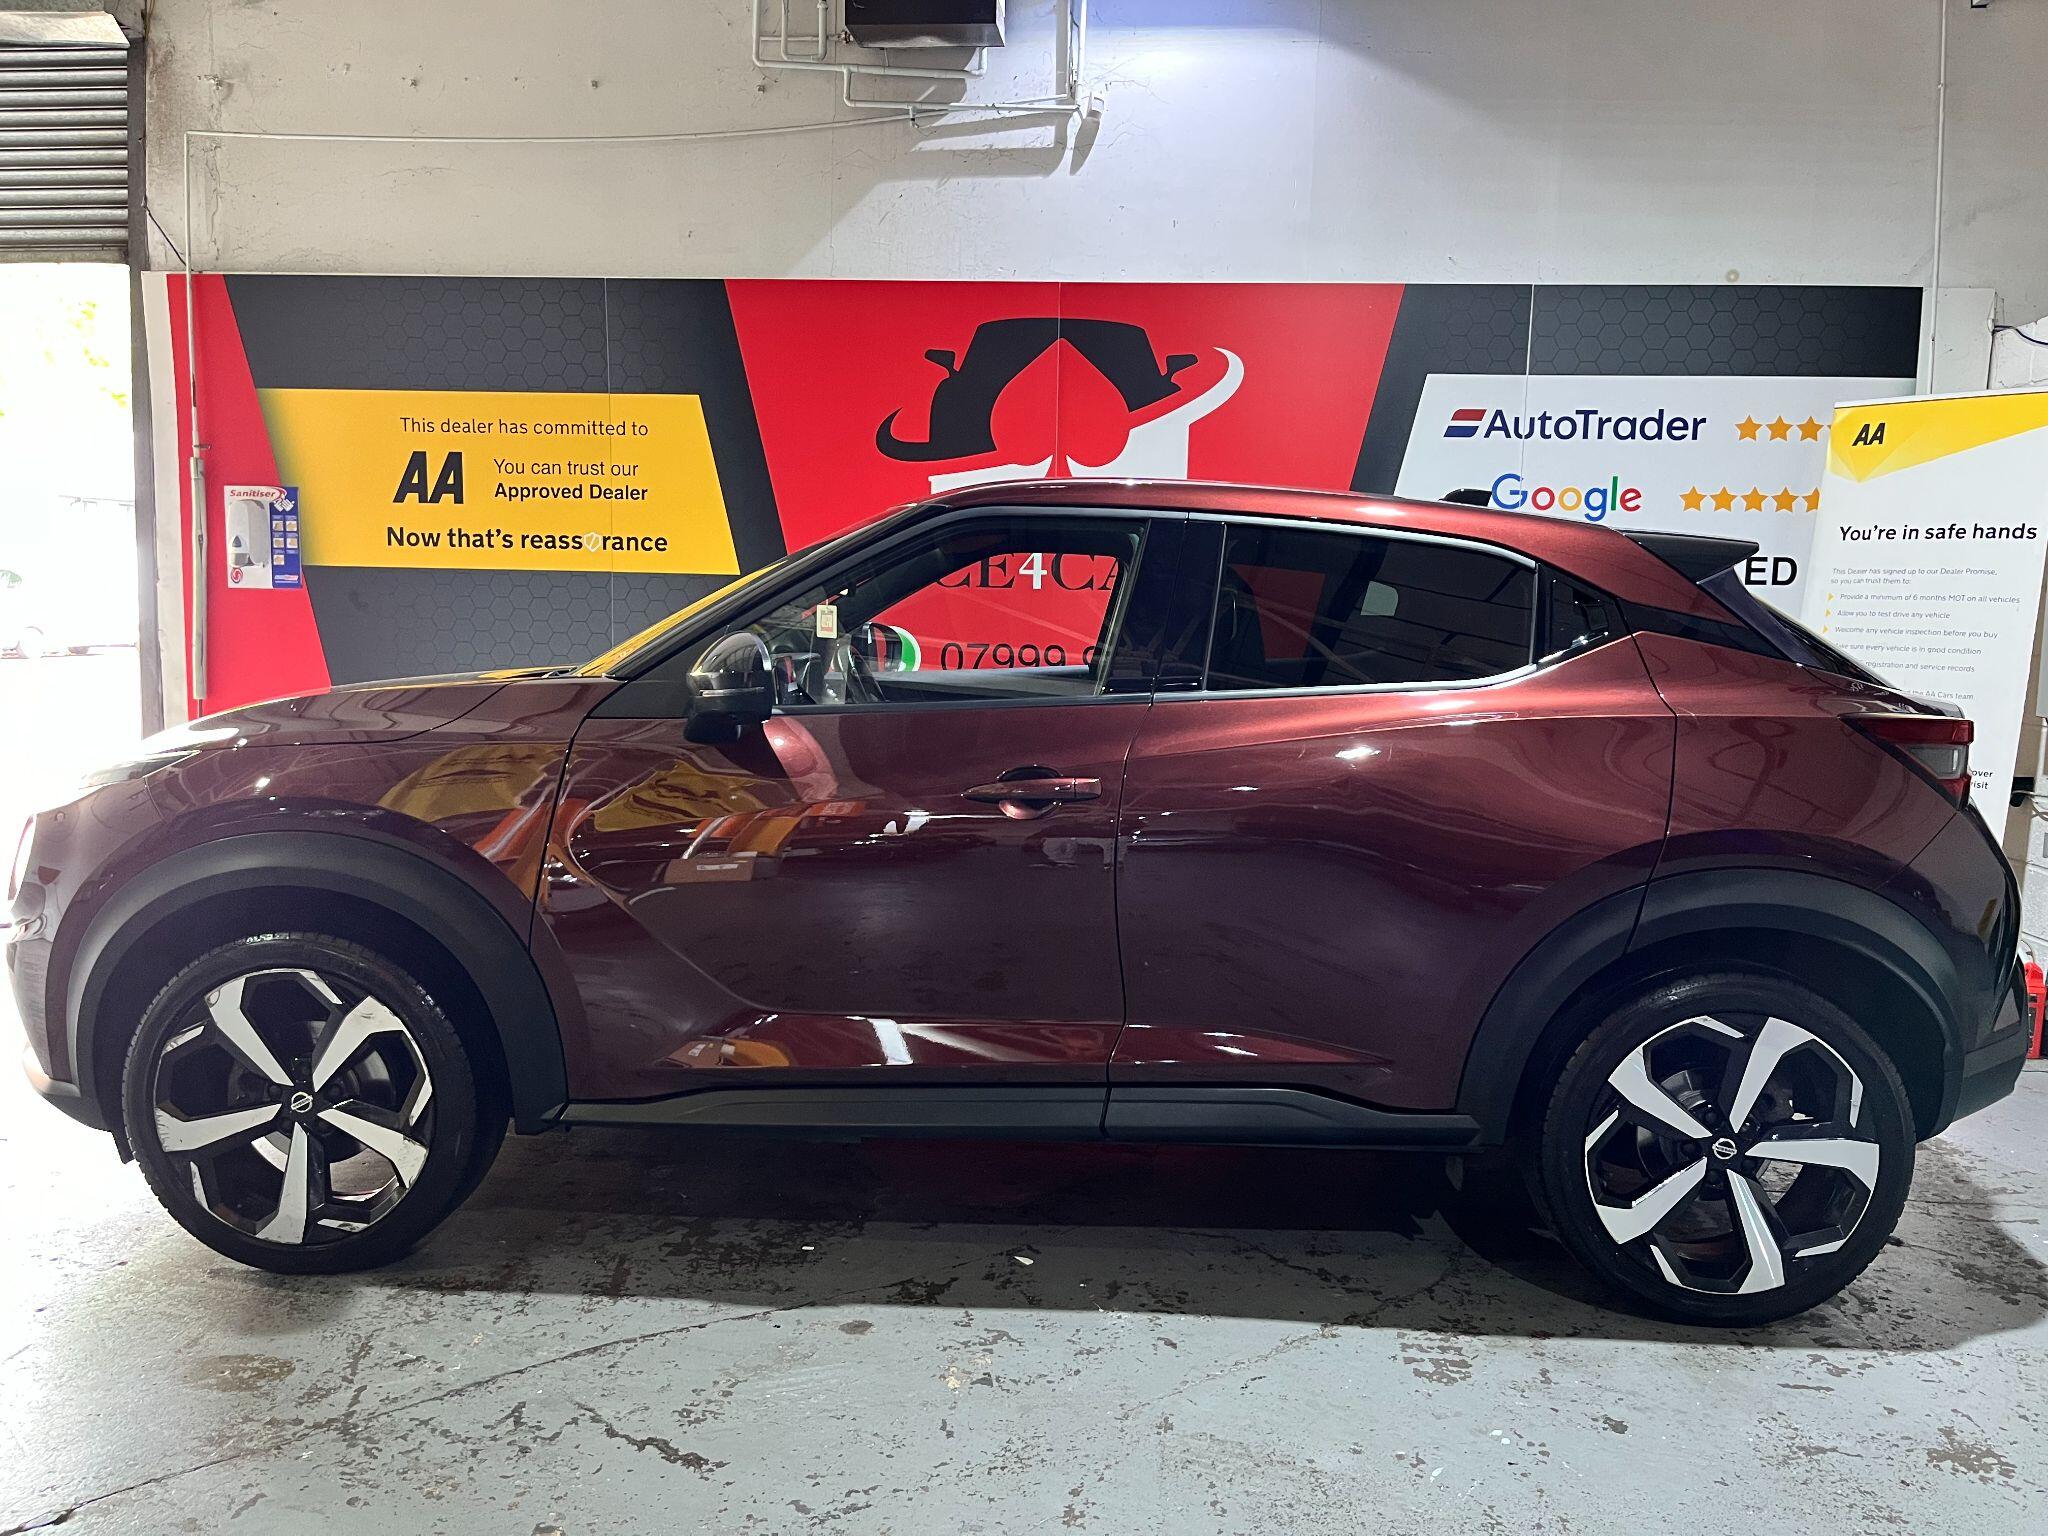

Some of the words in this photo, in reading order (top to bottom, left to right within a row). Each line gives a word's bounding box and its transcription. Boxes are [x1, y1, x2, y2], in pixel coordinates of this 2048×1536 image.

[400, 417, 435, 433] This
[440, 418, 494, 434] dealer
[499, 419, 528, 434] has
[534, 420, 626, 436] committed
[632, 422, 648, 436] to
[1484, 409, 1707, 441] AutoTrader
[1852, 422, 1886, 446] AA
[393, 450, 464, 504] AA
[494, 459, 525, 475] You
[531, 462, 561, 476] can
[567, 461, 605, 476] trust
[611, 463, 639, 477] our
[229, 489, 276, 498] Sanitiser
[495, 482, 583, 501] Approved
[590, 484, 648, 501] Dealer
[1491, 473, 1642, 522] Google
[387, 526, 441, 547] Now
[447, 527, 514, 549] that's
[1840, 525, 1897, 542] You're
[1902, 524, 1920, 541] in
[1925, 523, 1968, 541] safe
[1973, 522, 2038, 541] hands
[1882, 568, 1906, 576] signed
[1948, 594, 1966, 602] MOT
[1989, 596, 2020, 604] vehicles
[1892, 610, 1910, 618] drive
[1905, 629, 1942, 637] inspection
[1943, 629, 1967, 637] before
[1968, 631, 1982, 639] you
[1983, 631, 1998, 640] buy
[1886, 644, 1911, 652] vehicle
[1911, 645, 1918, 653] is
[1918, 645, 1926, 653] in
[1947, 647, 1982, 655] condition
[1905, 662, 1919, 670] and
[1920, 663, 1946, 671] service
[1947, 664, 1975, 673] records
[1937, 691, 1954, 699] Cars
